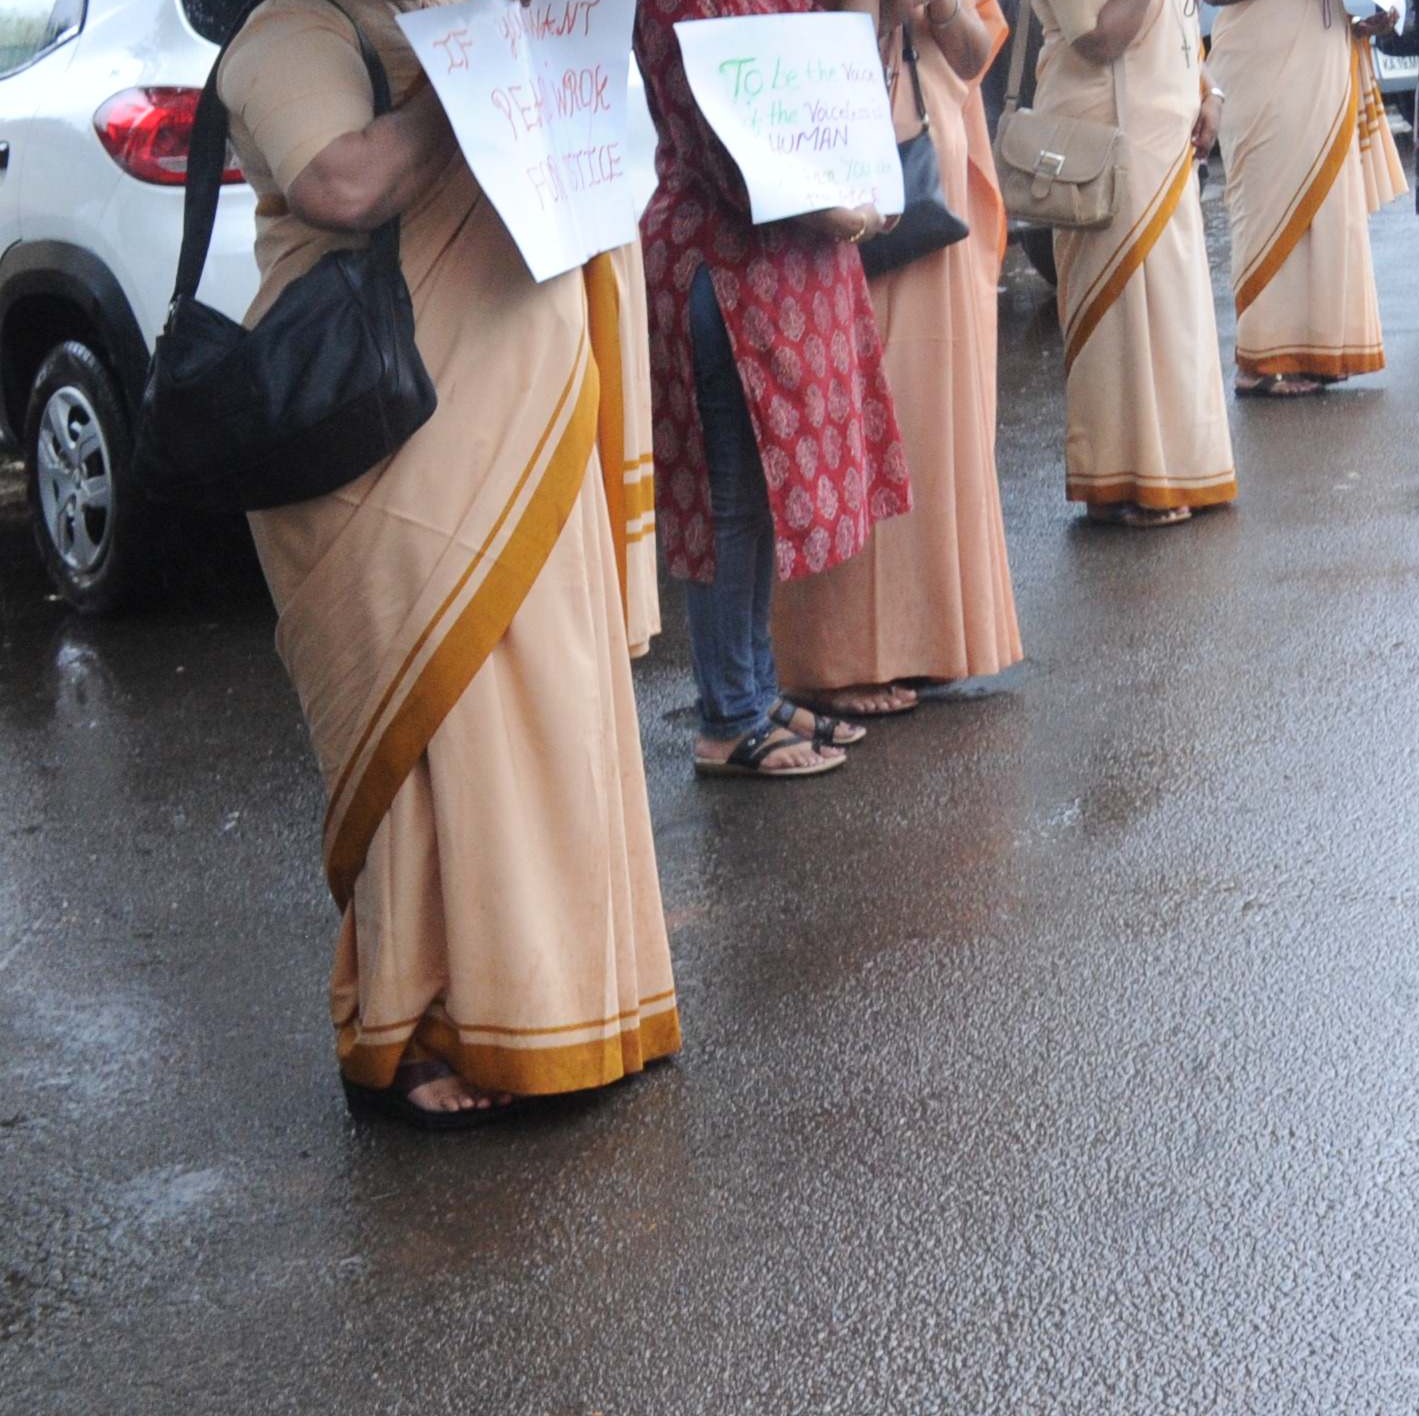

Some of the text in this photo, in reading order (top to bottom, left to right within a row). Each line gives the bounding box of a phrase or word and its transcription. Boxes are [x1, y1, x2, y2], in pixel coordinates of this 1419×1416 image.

[432, 28, 473, 75] IF
[772, 57, 799, 90] be
[805, 60, 836, 81] the
[769, 100, 799, 127] the
